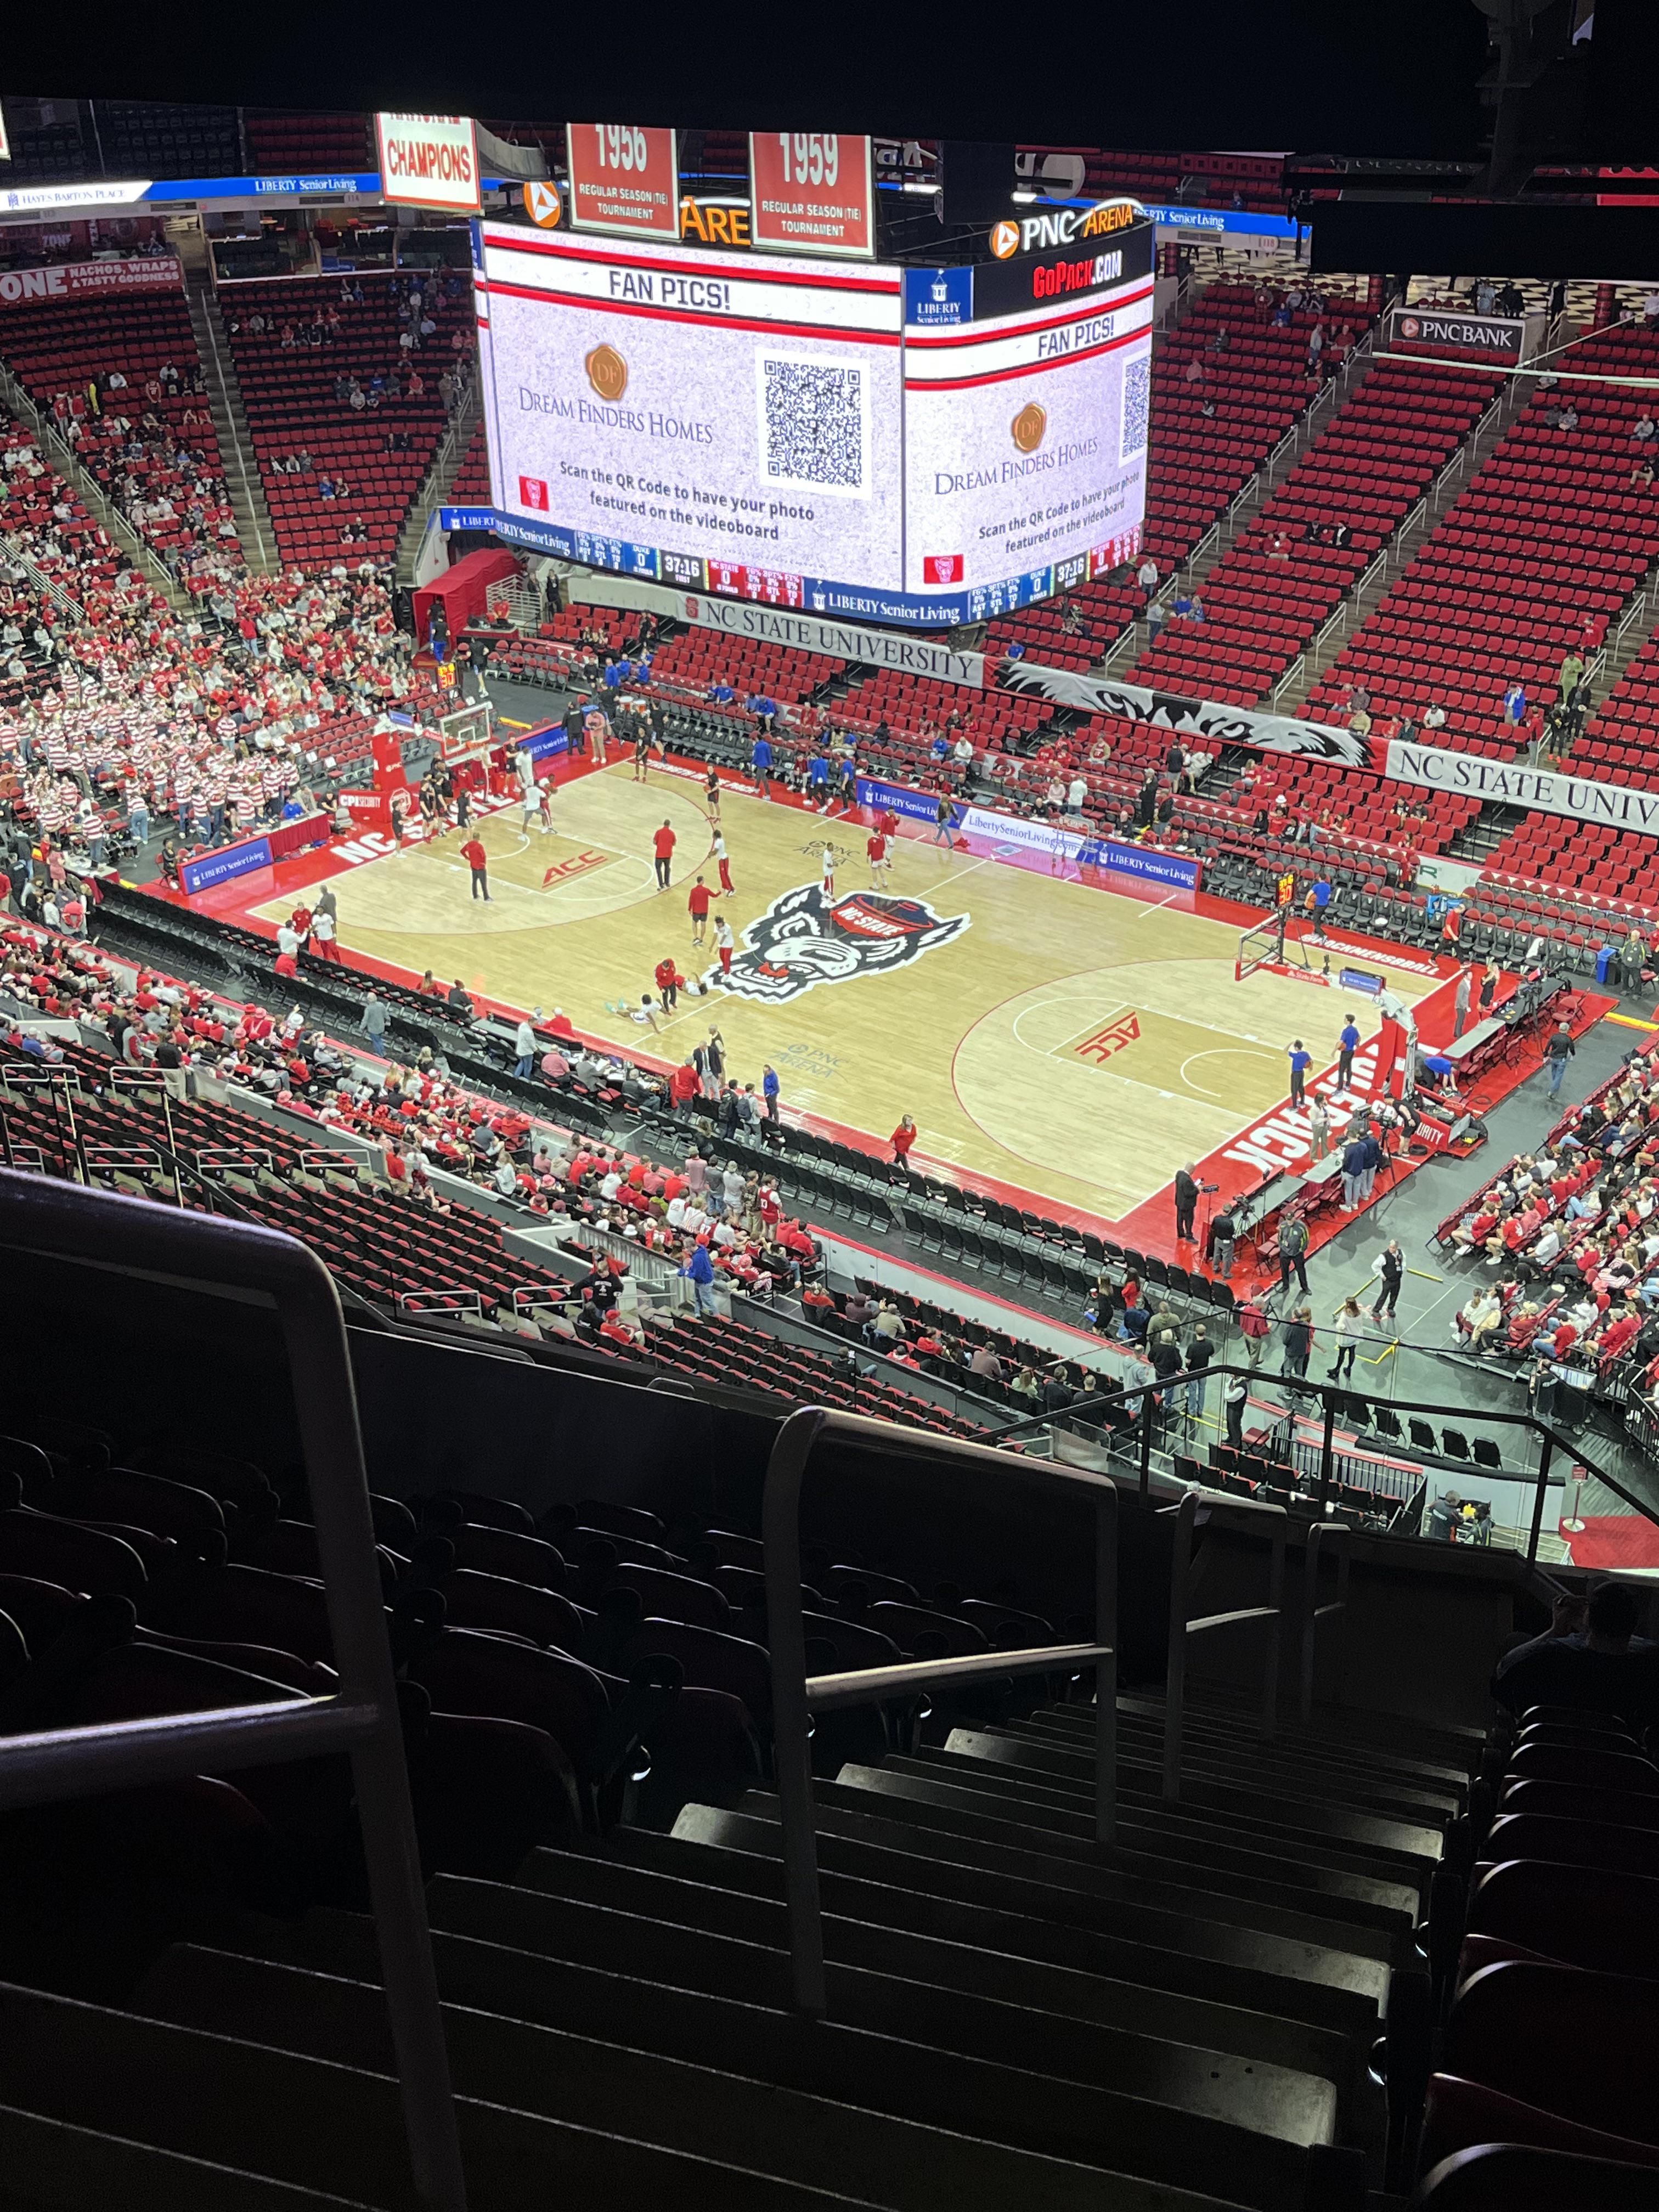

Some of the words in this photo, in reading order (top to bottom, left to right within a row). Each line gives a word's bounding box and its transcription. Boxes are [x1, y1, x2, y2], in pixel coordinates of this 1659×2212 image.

[596, 124, 647, 172] 1956
[387, 139, 471, 182] CHAMPIONS
[780, 132, 838, 187] 1959
[255, 180, 296, 191] LIBERTY
[300, 178, 329, 190] Senior
[329, 178, 357, 192] Living
[578, 183, 617, 198] REGULAR
[619, 187, 651, 202] SEASON
[653, 192, 668, 205] (TIE)
[22, 194, 53, 204] HAYES
[55, 192, 92, 201] BARTON
[95, 189, 125, 198] PLACE
[597, 202, 653, 219] TOURNAMENT
[680, 196, 751, 246] ARE
[761, 201, 803, 216] REGULAR
[806, 204, 842, 219] SEASON
[844, 208, 861, 222] (TIE)
[1169, 211, 1195, 224] Senior
[1198, 214, 1224, 231] Living
[781, 220, 845, 236] TOURNAMENT
[1022, 211, 1075, 250] PNC
[1084, 204, 1133, 237] ARENA
[70, 264, 126, 278] NACHOS,
[128, 261, 177, 273] WRAPS
[81, 275, 117, 286] TASTY
[119, 272, 179, 283] GOODNESS
[609, 271, 653, 300] FAN
[662, 277, 730, 310] PICS!
[917, 302, 961, 314] LIBERTY
[942, 315, 961, 326] Living
[1038, 329, 1070, 357] FAN
[1074, 316, 1114, 351] PICS!
[595, 362, 619, 383] DF
[1022, 421, 1038, 438] DF
[560, 460, 589, 477] Scan
[591, 466, 613, 484] the
[616, 471, 635, 490] QR
[638, 477, 671, 496] Code
[674, 484, 689, 499] to
[692, 486, 727, 508] have
[730, 495, 765, 516] your
[769, 500, 815, 523] photo
[589, 490, 645, 515] featured
[650, 505, 665, 520] on
[668, 506, 692, 524] the
[696, 514, 778, 540] videoboard
[979, 521, 1005, 539] Scan
[1008, 514, 1026, 530] the
[1029, 511, 1043, 525] QR
[1046, 503, 1069, 521] Code
[1071, 499, 1080, 512] to
[1082, 492, 1102, 509] have
[1103, 484, 1120, 506] your
[1122, 471, 1139, 493] photo
[462, 517, 495, 527] LIBERT
[1006, 530, 1050, 554] featured
[1053, 526, 1064, 538] on
[1066, 519, 1081, 534] the
[1082, 496, 1125, 525] videoboard
[520, 527, 544, 545] Senior
[544, 535, 569, 555] Living
[637, 553, 645, 566] 0
[664, 555, 699, 577] 37:16
[720, 562, 738, 573] STATE
[1057, 558, 1084, 582] 37:16
[1098, 552, 1104, 566] 0
[722, 571, 730, 584] 0
[1030, 568, 1046, 579] DUKE
[1034, 578, 1041, 592] 0
[829, 593, 879, 613] LIBERTY
[880, 602, 918, 620] Senior
[919, 603, 960, 624] Living
[706, 601, 736, 628] NC
[743, 611, 811, 645] STATE
[818, 627, 973, 679] UNIVERSITY
[1400, 749, 1443, 780] NC
[1454, 761, 1554, 804] STATE
[340, 795, 358, 806] CPI
[358, 797, 380, 808] SECURITY
[874, 792, 904, 809] LIBERTY
[905, 799, 928, 814] Senior
[968, 815, 1079, 851] LibertySeniorLiving.com
[330, 832, 396, 864] NC
[792, 847, 847, 865] AREA
[543, 850, 605, 885] ACC
[1110, 852, 1143, 869] LIBERTY
[1144, 861, 1170, 878] Senior
[1170, 868, 1194, 884] Living
[838, 907, 863, 921] NC
[854, 914, 904, 935] STATE
[1079, 1015, 1141, 1063] ACC
[769, 1052, 834, 1078] ARENA
[807, 1050, 849, 1067] PNC
